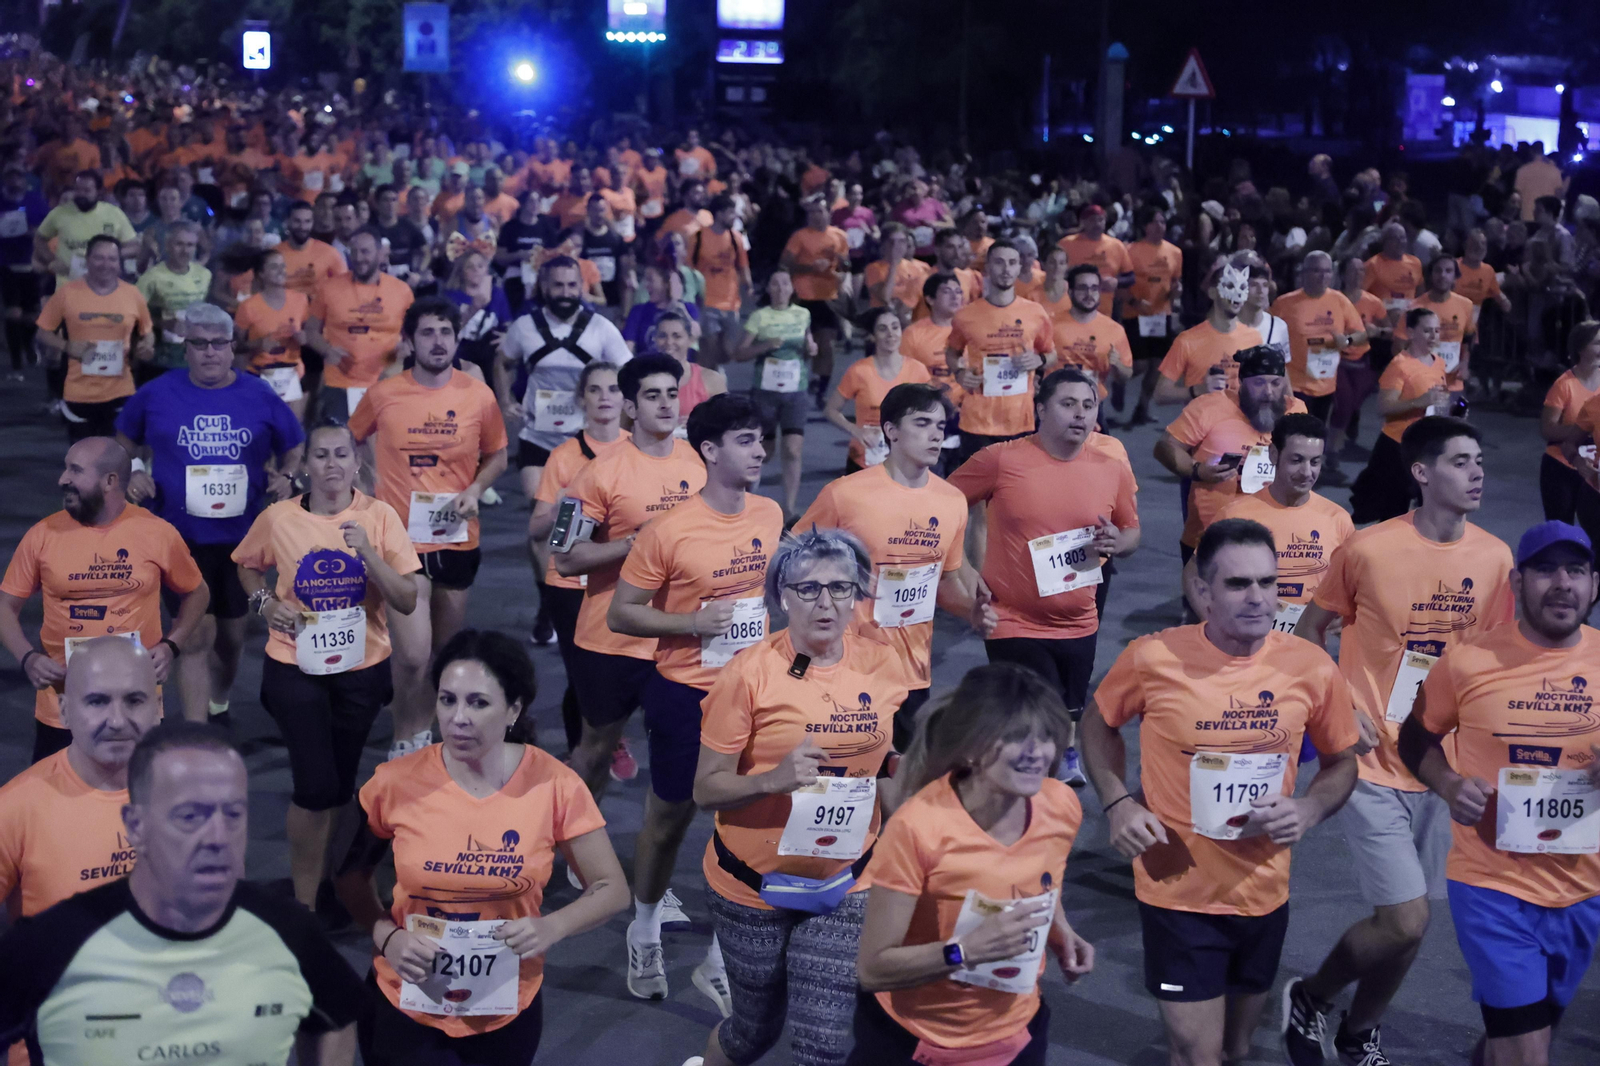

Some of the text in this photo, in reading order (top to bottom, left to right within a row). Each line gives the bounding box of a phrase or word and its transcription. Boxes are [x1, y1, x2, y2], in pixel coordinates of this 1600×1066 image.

[195, 415, 230, 432] CLUB
[178, 427, 252, 446] ATLETISMO
[190, 442, 240, 459] ORIPPO
[202, 482, 237, 496] 16331
[660, 494, 693, 503] NOCTURN
[428, 510, 457, 523] 7345
[903, 530, 941, 540] NOCTURNA
[887, 537, 940, 548] SEVILLA KH7
[1286, 543, 1324, 551] NOCTURNA
[730, 554, 767, 566] NOCTURNA
[1048, 548, 1087, 569] 11803
[1305, 551, 1324, 559] KH7
[68, 571, 132, 580] SEVILLA KH7
[712, 561, 767, 578] SEVILLA KH7
[296, 576, 364, 588] LA NOCTURNA
[894, 584, 928, 603] 10916
[1431, 593, 1475, 604] NOCTURNA
[1411, 602, 1473, 614] SEVILLA KH7
[311, 629, 355, 649] 11336
[1534, 692, 1594, 702] NOCTURNA
[1507, 700, 1593, 714] SEVILLA KH7
[829, 712, 879, 723] NOCTURNA
[1222, 709, 1279, 719] NOCTURNA
[804, 721, 878, 734] SEVILLA KH7
[1195, 718, 1279, 731] SEVILLA KH7
[1522, 797, 1585, 819] 11805
[814, 805, 856, 826] 9197
[456, 852, 525, 864] NOCTURNA
[80, 863, 128, 881] SEVILL
[422, 860, 524, 879] SEVILLA KH7
[432, 953, 497, 977] 12107
[137, 1040, 222, 1062] CARLOS
